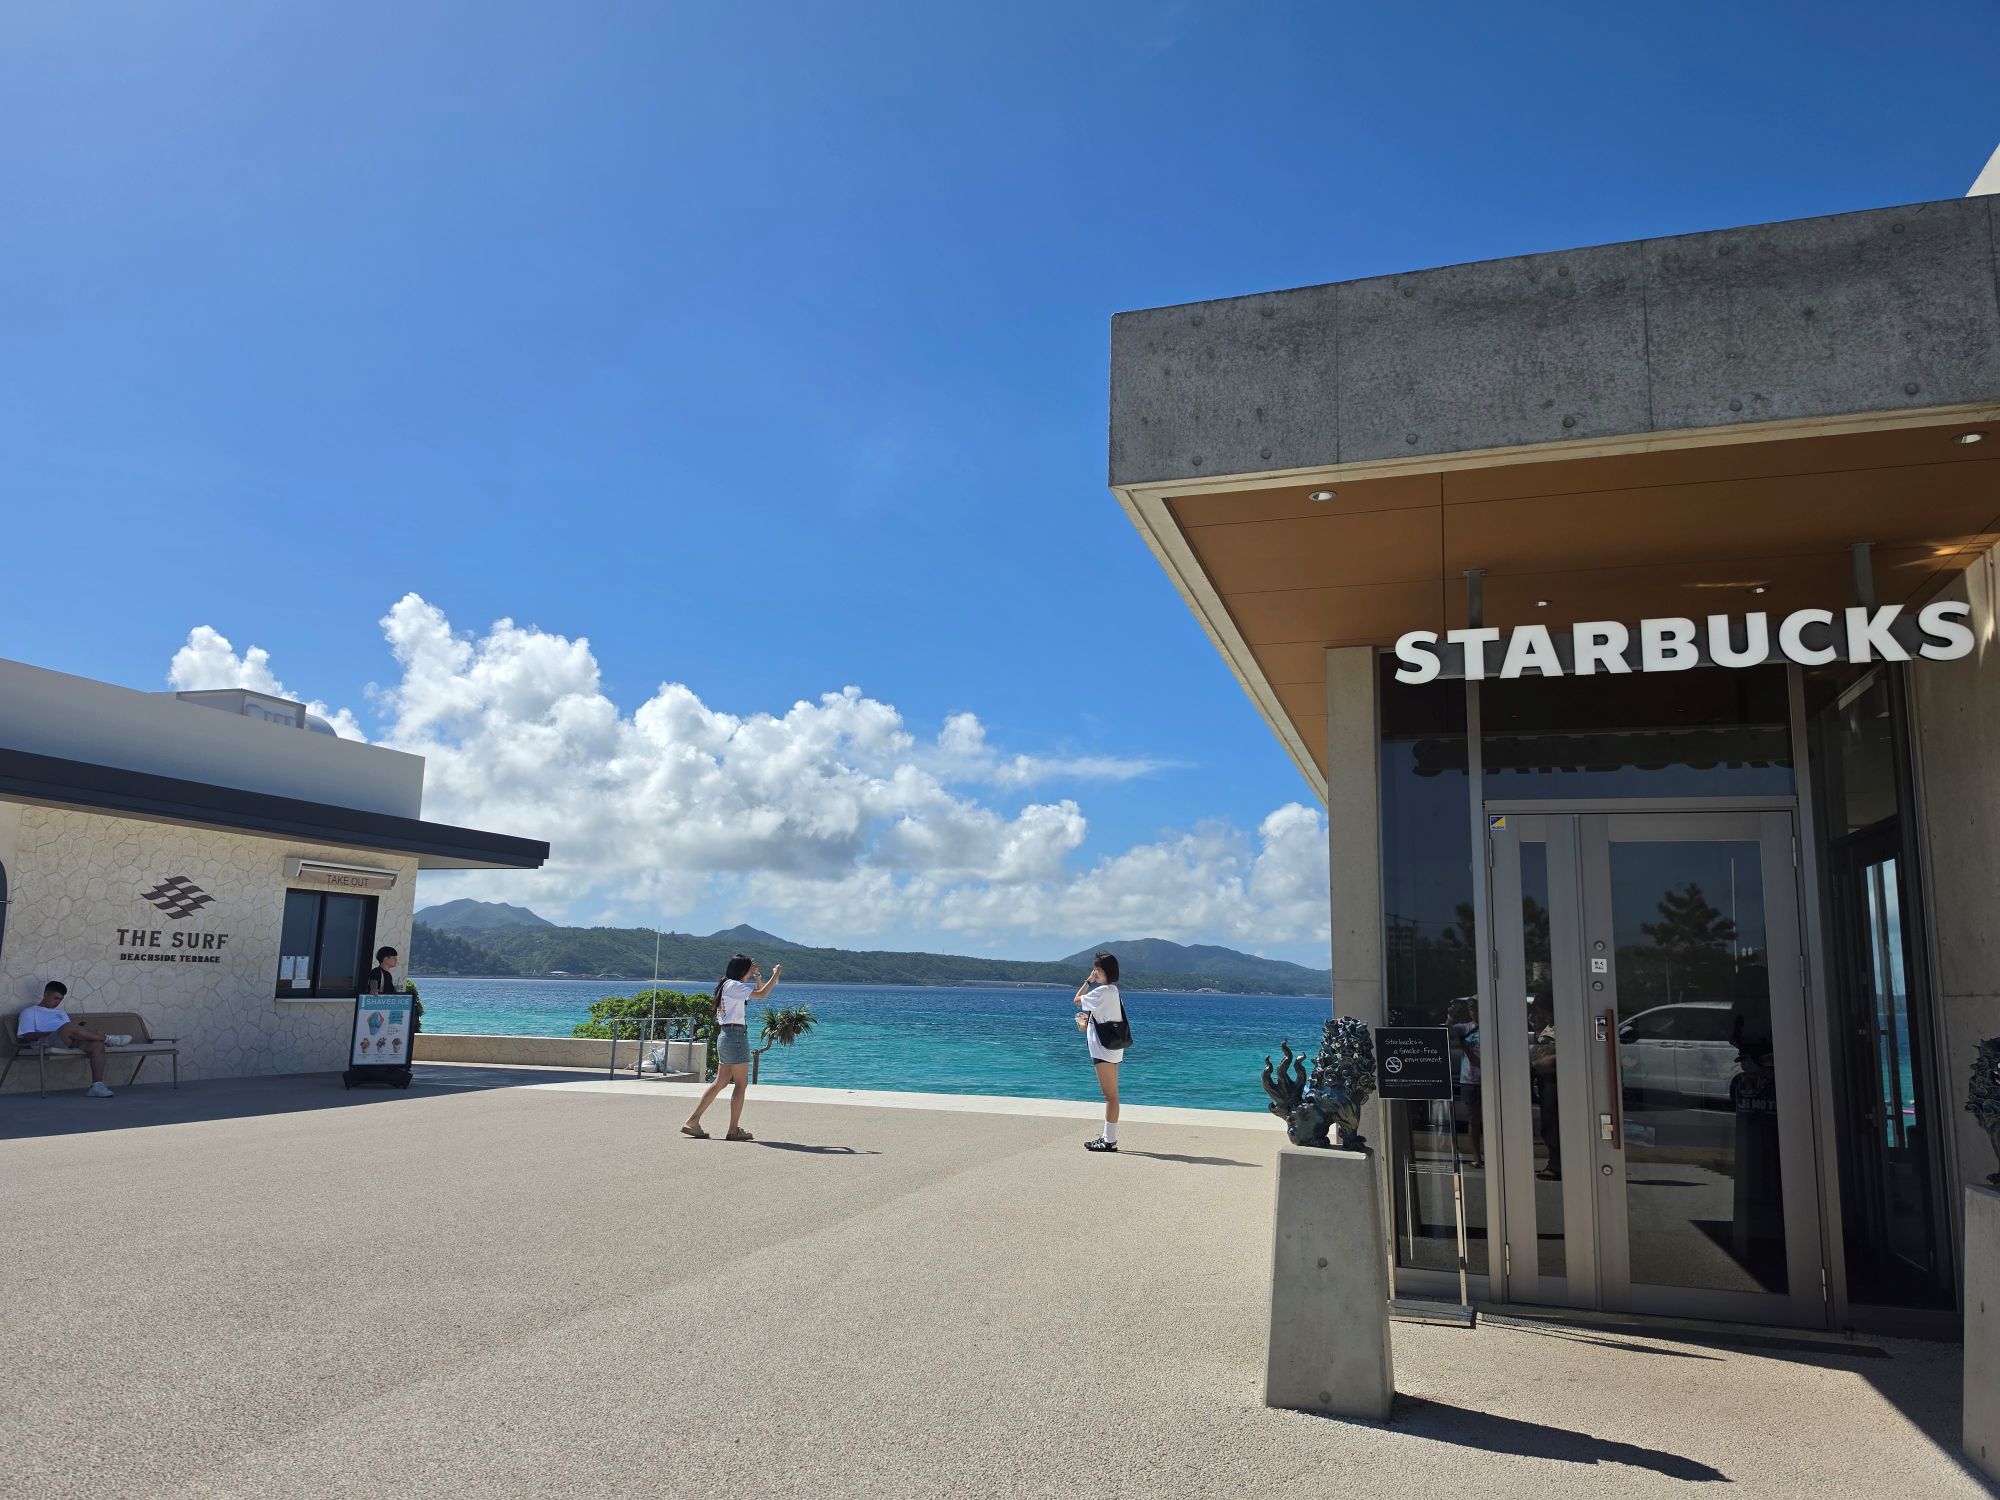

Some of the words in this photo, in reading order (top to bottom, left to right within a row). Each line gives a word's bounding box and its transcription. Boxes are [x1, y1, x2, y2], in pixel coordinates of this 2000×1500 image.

[1394, 601, 1976, 685] STARBUCKS
[327, 873, 349, 886] TAKE
[351, 877, 369, 887] OUT
[117, 928, 162, 948] THE
[171, 931, 229, 950] SURF
[120, 953, 177, 962] BEACHSIDE
[179, 954, 221, 963] TERRACE
